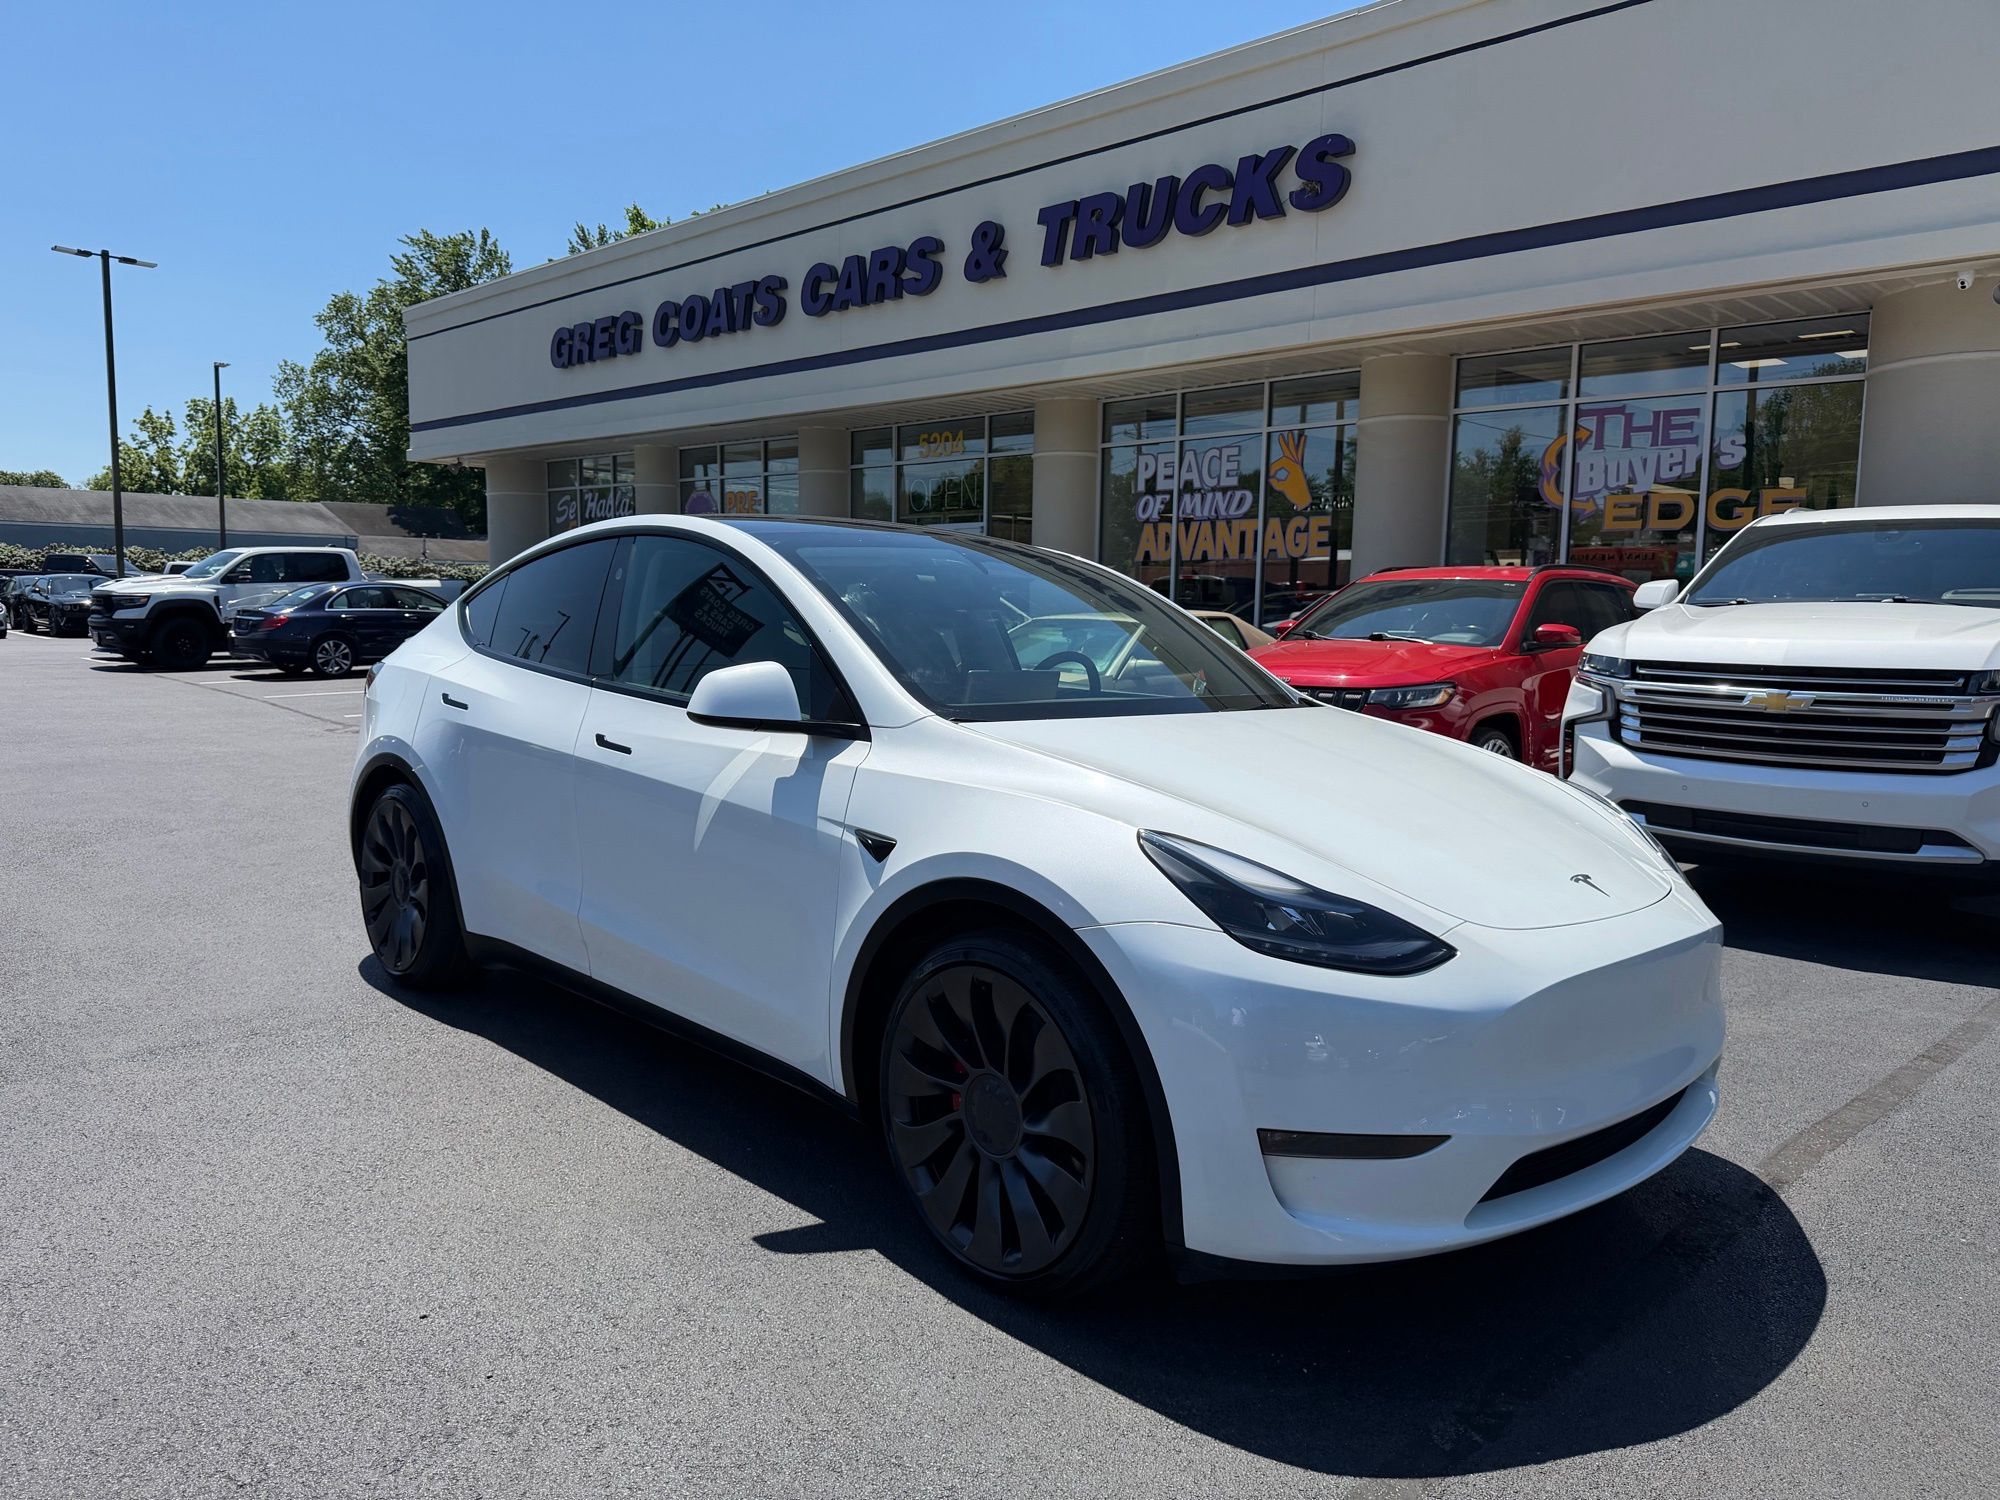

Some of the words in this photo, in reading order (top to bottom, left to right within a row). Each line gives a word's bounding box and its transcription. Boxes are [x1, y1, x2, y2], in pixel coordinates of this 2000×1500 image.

[550, 311, 642, 369] GREG
[652, 275, 788, 348] COATS
[801, 236, 945, 317] CARS
[964, 220, 1008, 283] &
[1037, 133, 1356, 268] TRUCKS
[918, 430, 965, 459] 5204
[1577, 404, 1701, 451] THE
[1137, 446, 1240, 492] PEACE
[555, 494, 577, 524] Se
[584, 488, 633, 520] Habla
[910, 472, 979, 512] OPEN
[1135, 494, 1171, 522] OF
[1179, 489, 1253, 520] MIND
[1135, 515, 1332, 561] ADVANTAGE
